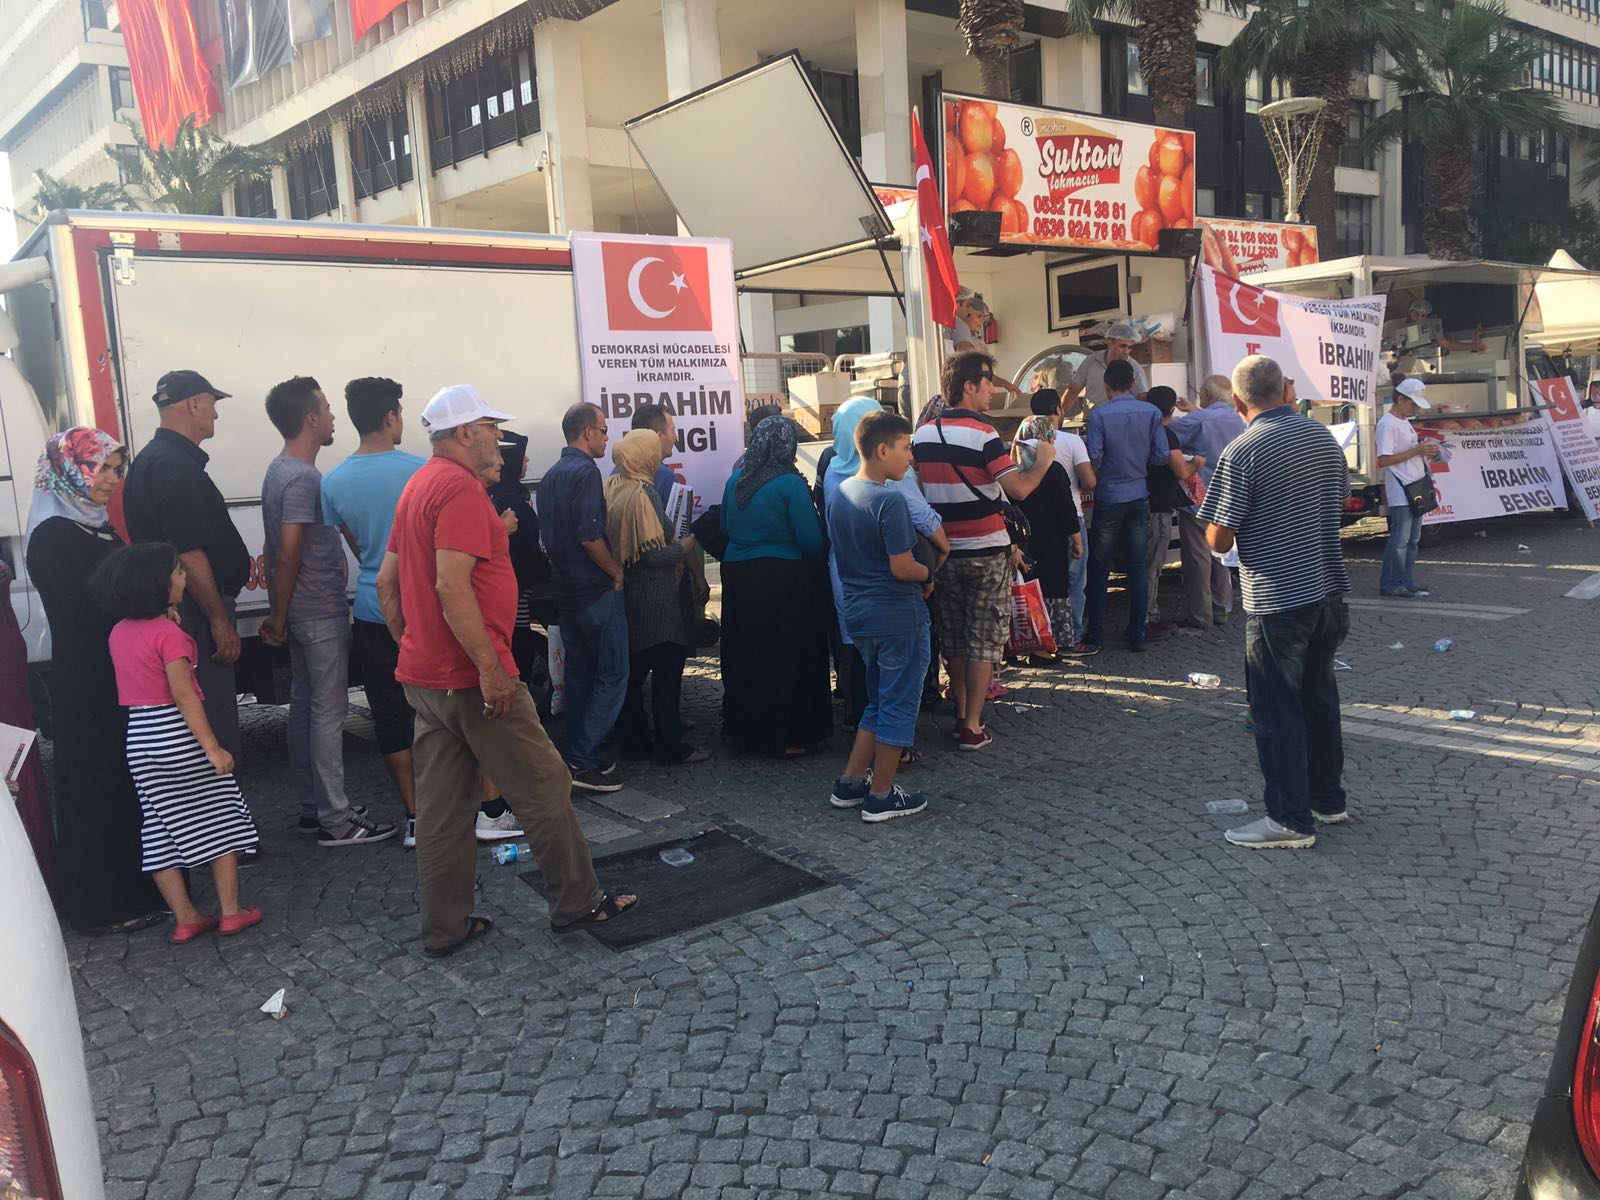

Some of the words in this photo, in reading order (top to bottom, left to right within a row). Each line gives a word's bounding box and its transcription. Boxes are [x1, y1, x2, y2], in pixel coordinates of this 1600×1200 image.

[1039, 137, 1123, 178] Sultan
[1050, 174, 1100, 190] lokmacısı
[1034, 194, 1065, 215] 0532
[1068, 198, 1091, 217] 774
[1094, 200, 1110, 218] 38
[1112, 202, 1126, 220] 81
[1034, 216, 1065, 237] 0536
[1068, 219, 1090, 239] 924
[1094, 222, 1108, 240] 76
[1111, 222, 1126, 241] 90
[1330, 319, 1366, 338] İKRAMDIR.
[591, 342, 660, 355] DEMOKRASİ
[662, 342, 731, 354] MÜCADELESİ
[1318, 336, 1374, 373] İBRAHİM
[598, 358, 638, 370] VEREN
[642, 356, 666, 368] TÜM
[668, 357, 728, 368] HALKIMIZA
[636, 370, 695, 382] İKRAMDIR.
[1330, 374, 1368, 402] BENGİ
[1462, 440, 1486, 449] VEREN
[1488, 438, 1504, 448] TÜM
[1489, 450, 1528, 461] İKRAMDIR.
[1480, 464, 1552, 489] İBRAHİM
[1570, 464, 1600, 484] İBRAHİ
[1499, 486, 1556, 512] BENGİ
